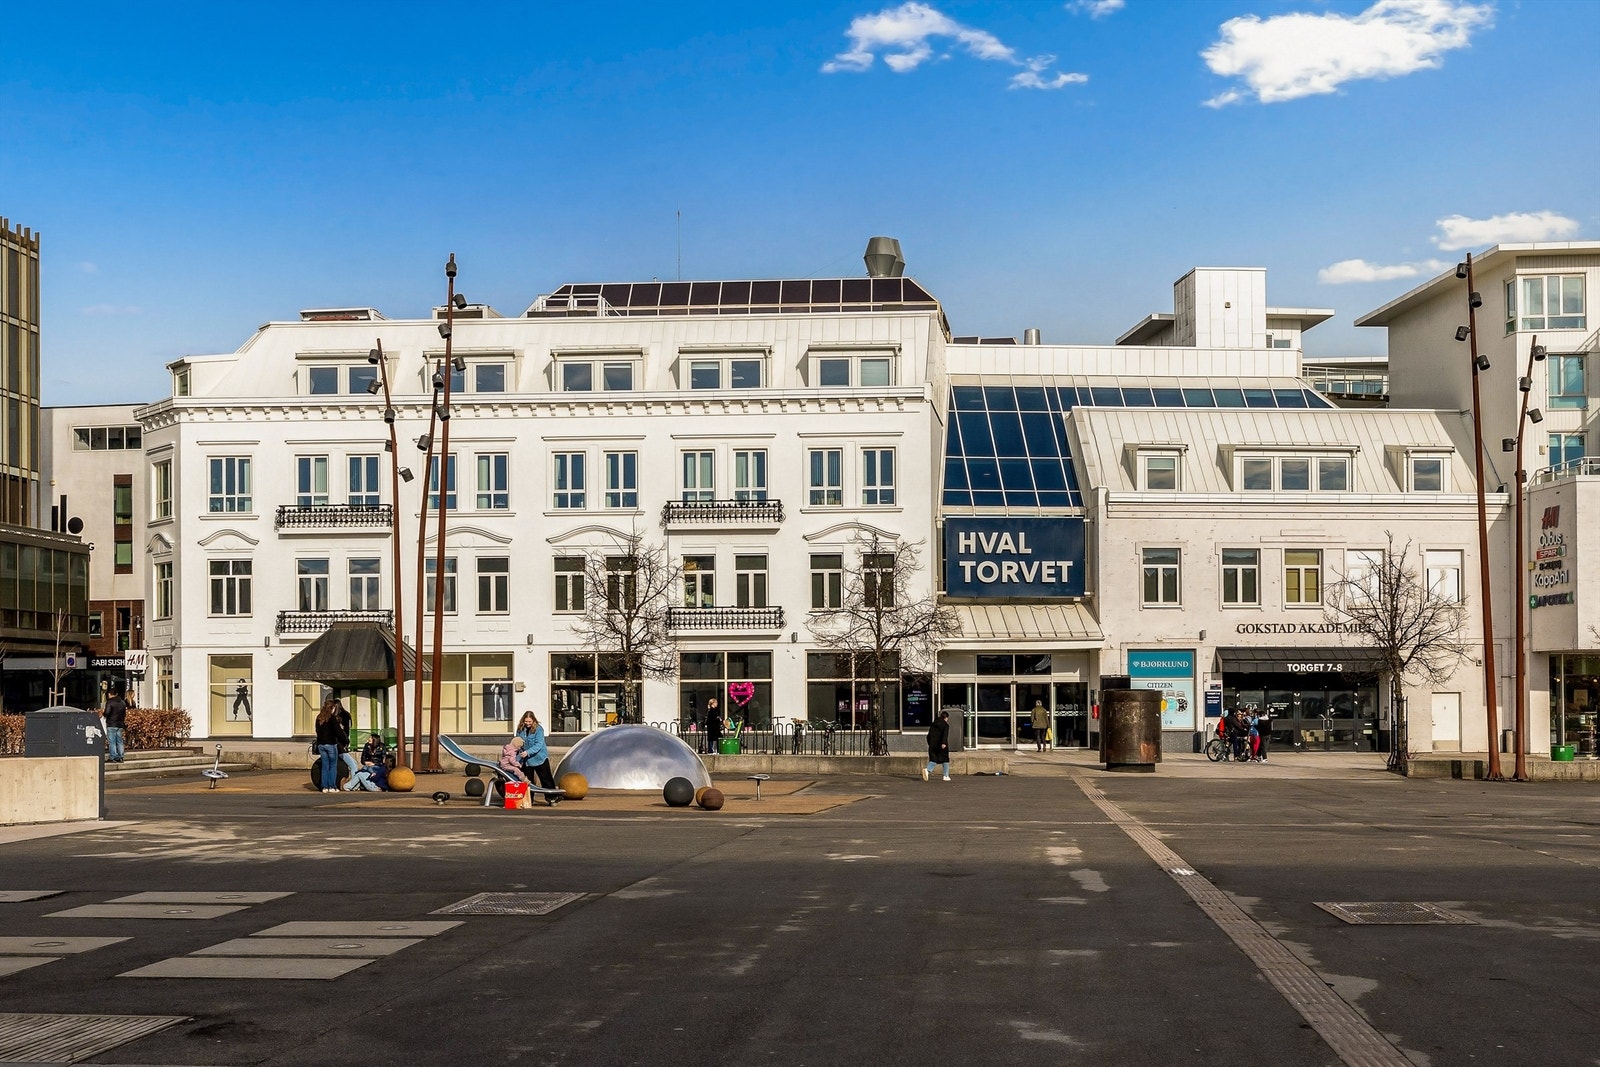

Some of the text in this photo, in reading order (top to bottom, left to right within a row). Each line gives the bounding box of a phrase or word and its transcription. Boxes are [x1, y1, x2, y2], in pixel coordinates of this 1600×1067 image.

[958, 531, 1032, 555] HVAL
[1540, 549, 1557, 558] SPAR
[959, 560, 1074, 584] TORVET
[1535, 570, 1569, 588] KappAhl
[1538, 593, 1567, 607] APOTEK
[1236, 623, 1297, 634] GOKSTAD
[91, 659, 125, 667] SABI SUSH
[126, 653, 145, 669] H&M
[1140, 660, 1189, 668] BJØRKLUND
[1287, 663, 1343, 672] TORGET 7-8
